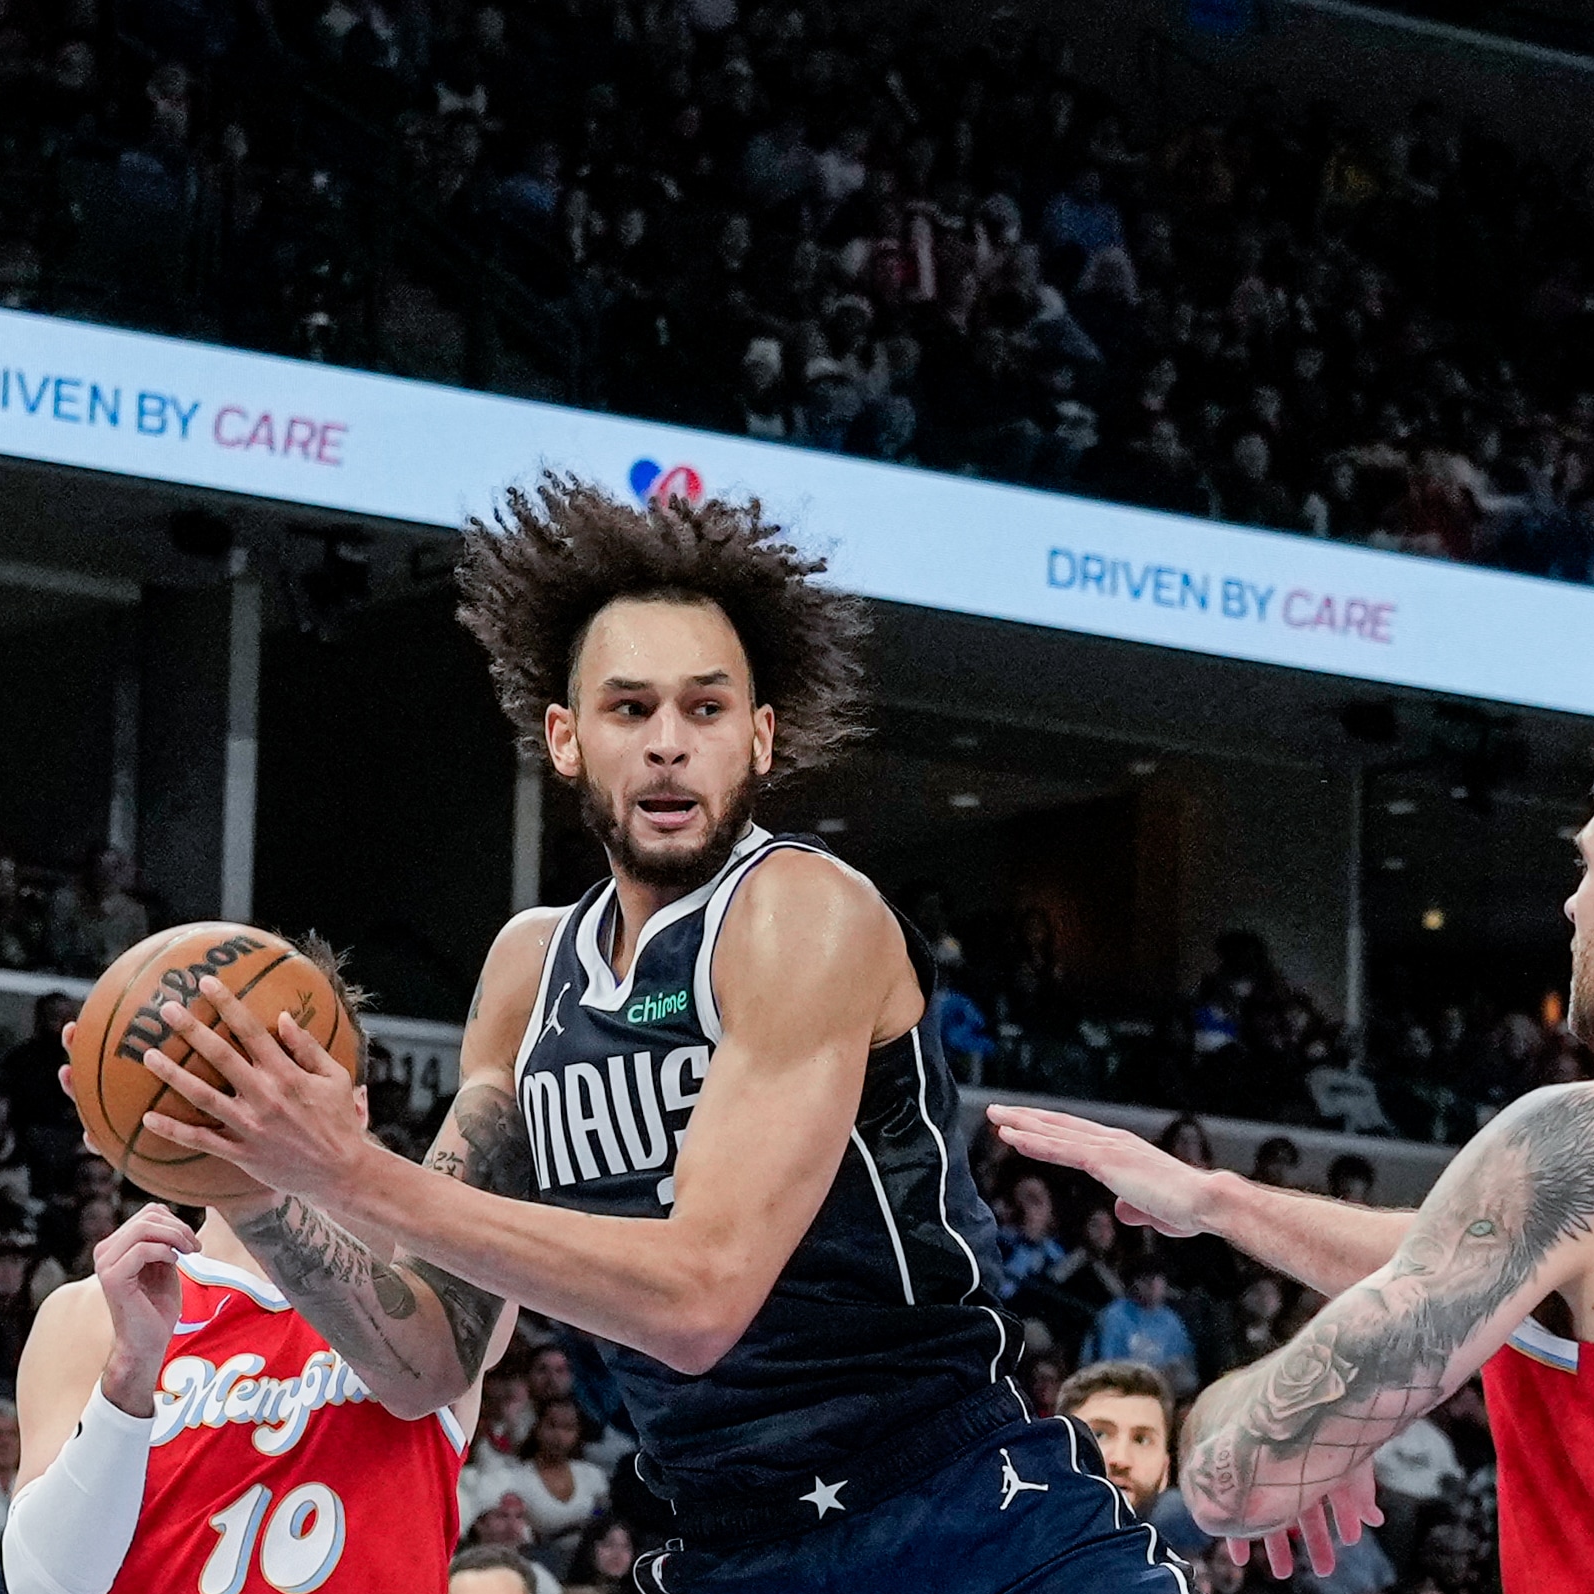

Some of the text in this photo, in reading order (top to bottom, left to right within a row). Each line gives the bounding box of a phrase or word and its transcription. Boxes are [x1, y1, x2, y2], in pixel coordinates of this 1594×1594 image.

[136, 389, 202, 441] BY
[212, 404, 348, 467] CARE
[1046, 546, 1397, 645] DRIVEN BY CARE
[627, 989, 689, 1024] chime
[523, 1045, 710, 1191] MAVS
[149, 1348, 379, 1457] Memph
